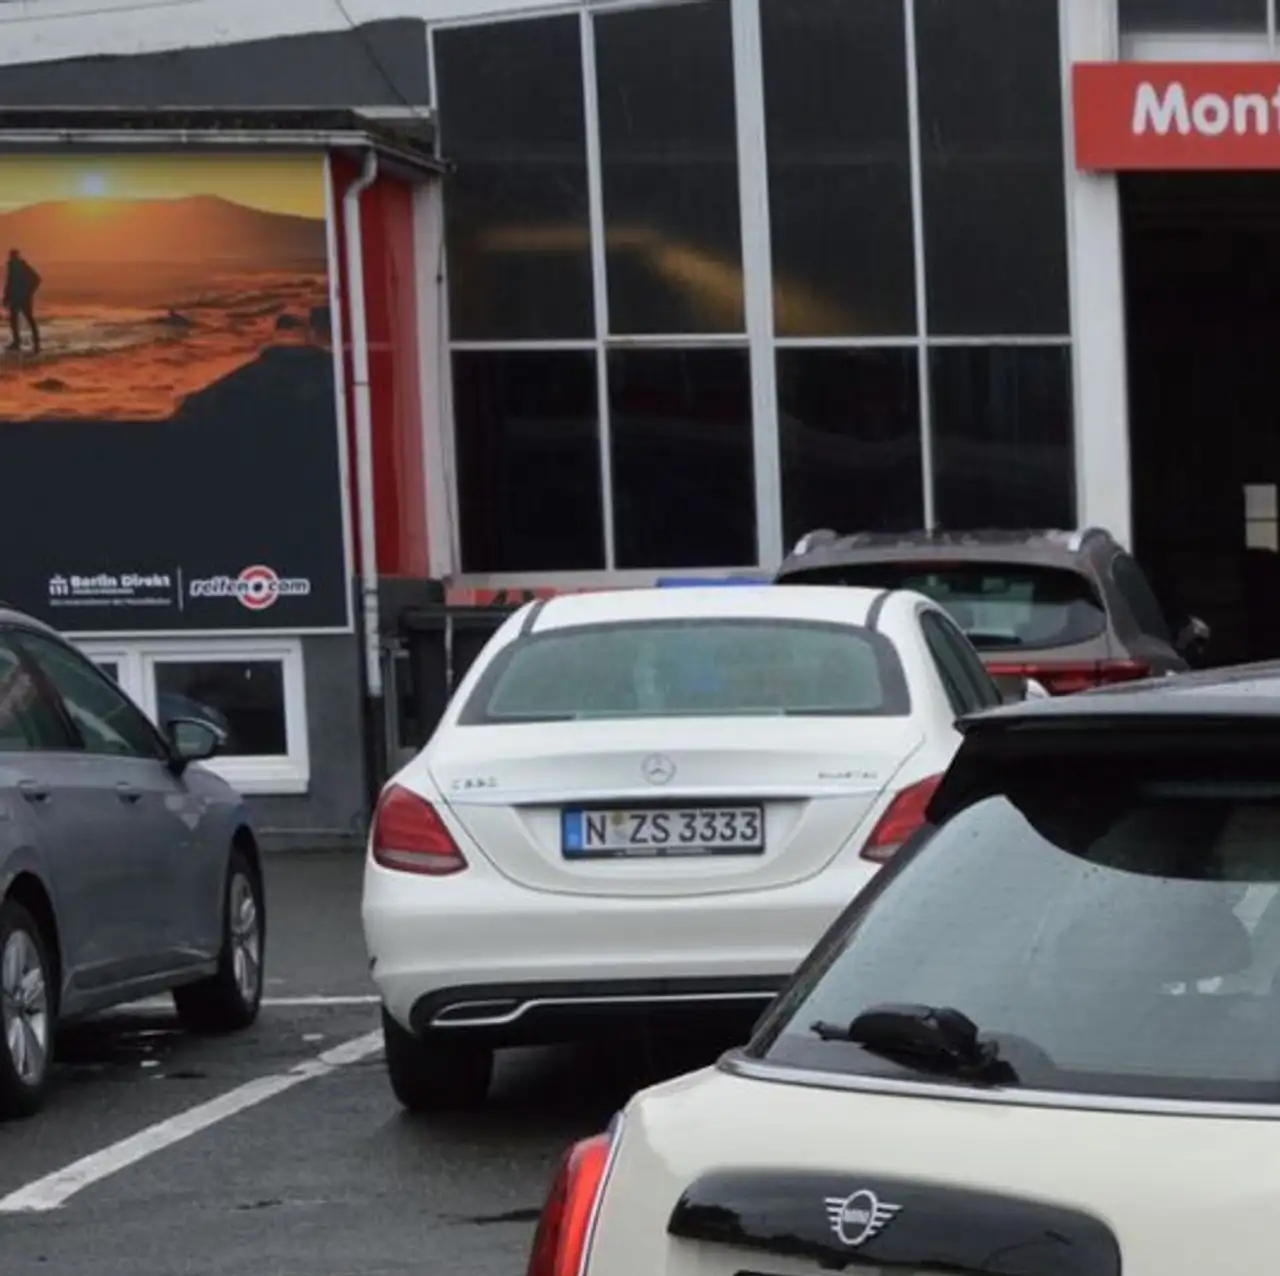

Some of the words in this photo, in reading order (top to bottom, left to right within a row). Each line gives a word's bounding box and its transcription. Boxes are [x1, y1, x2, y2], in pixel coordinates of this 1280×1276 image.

[70, 573, 119, 588] Berlin
[121, 573, 170, 588] Direkt
[586, 814, 607, 846] N
[629, 813, 671, 844] ZS
[678, 810, 758, 843] 3333
